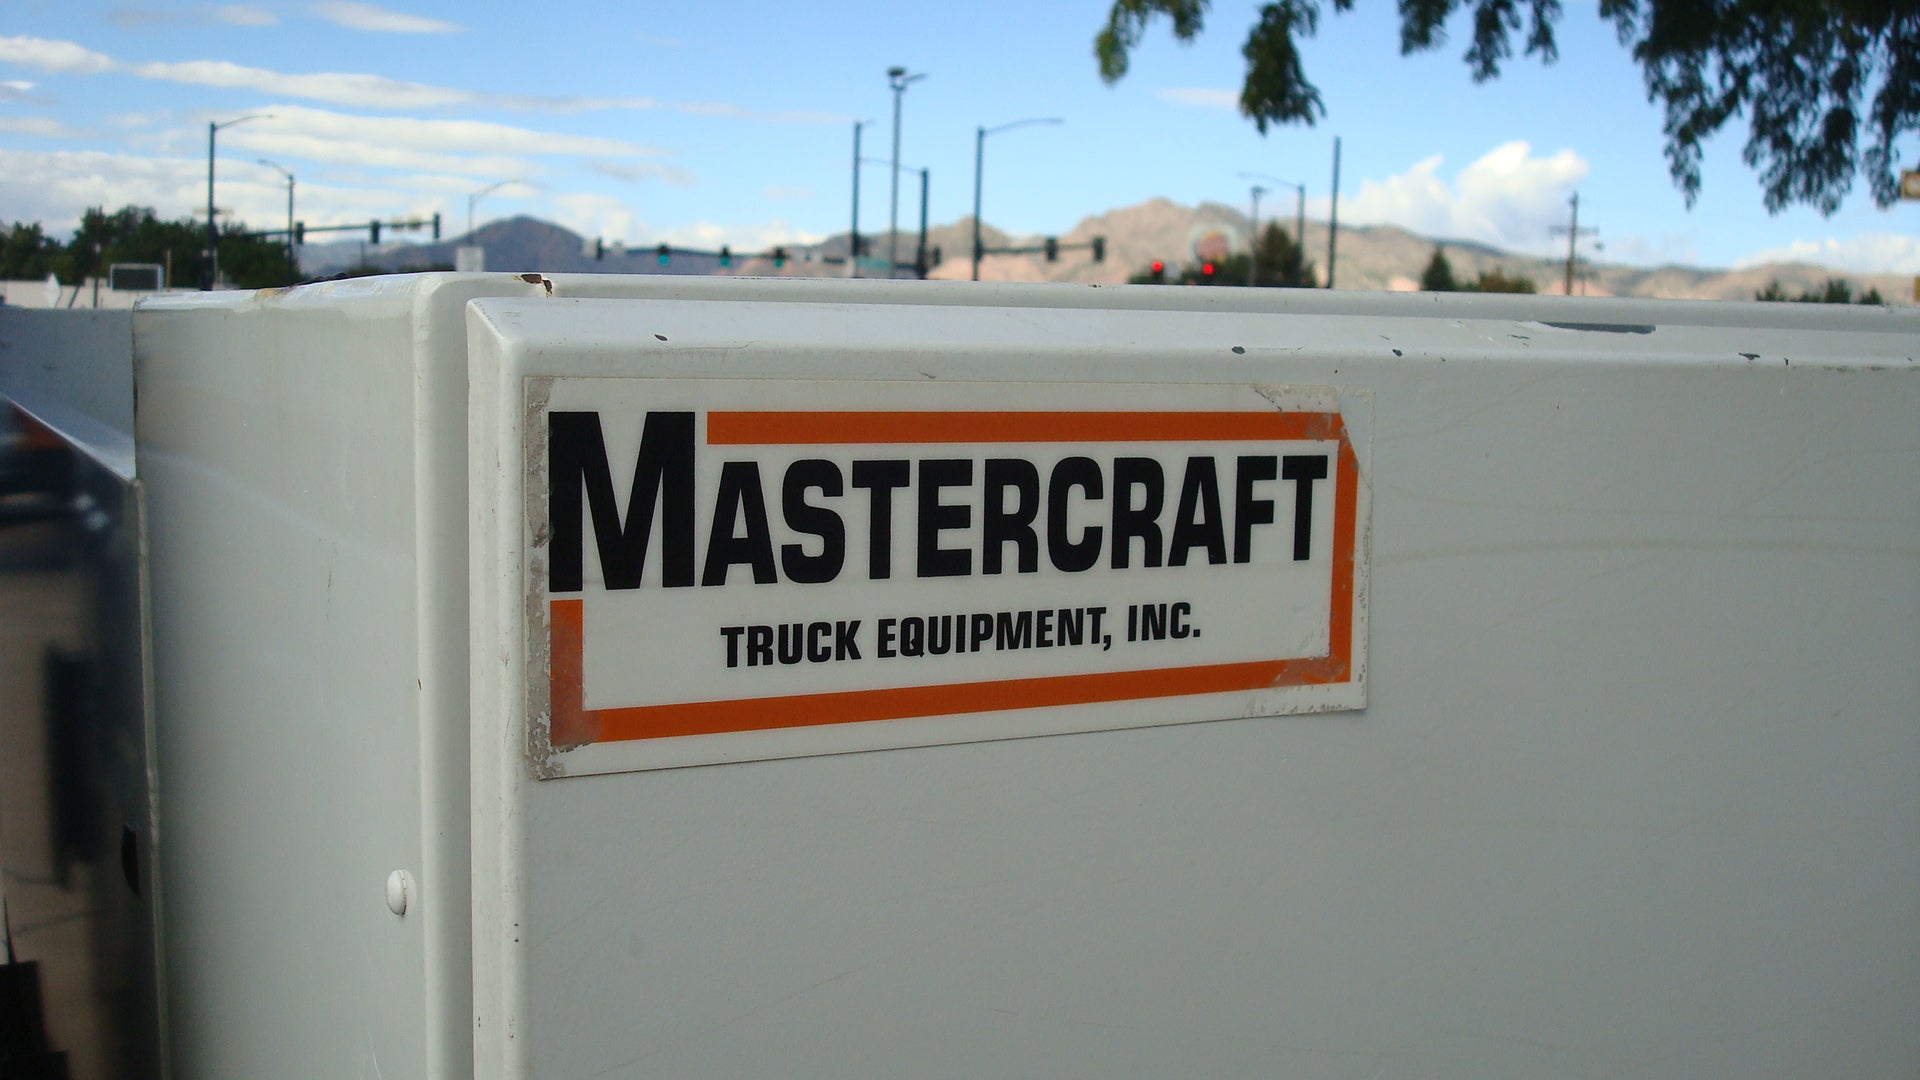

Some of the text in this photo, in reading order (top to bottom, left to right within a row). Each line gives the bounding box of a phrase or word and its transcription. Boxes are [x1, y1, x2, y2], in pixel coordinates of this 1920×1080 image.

[548, 411, 1329, 592] MASTERCRAFT
[720, 601, 1201, 669] TRUCK EQUIPMENT, INC.
